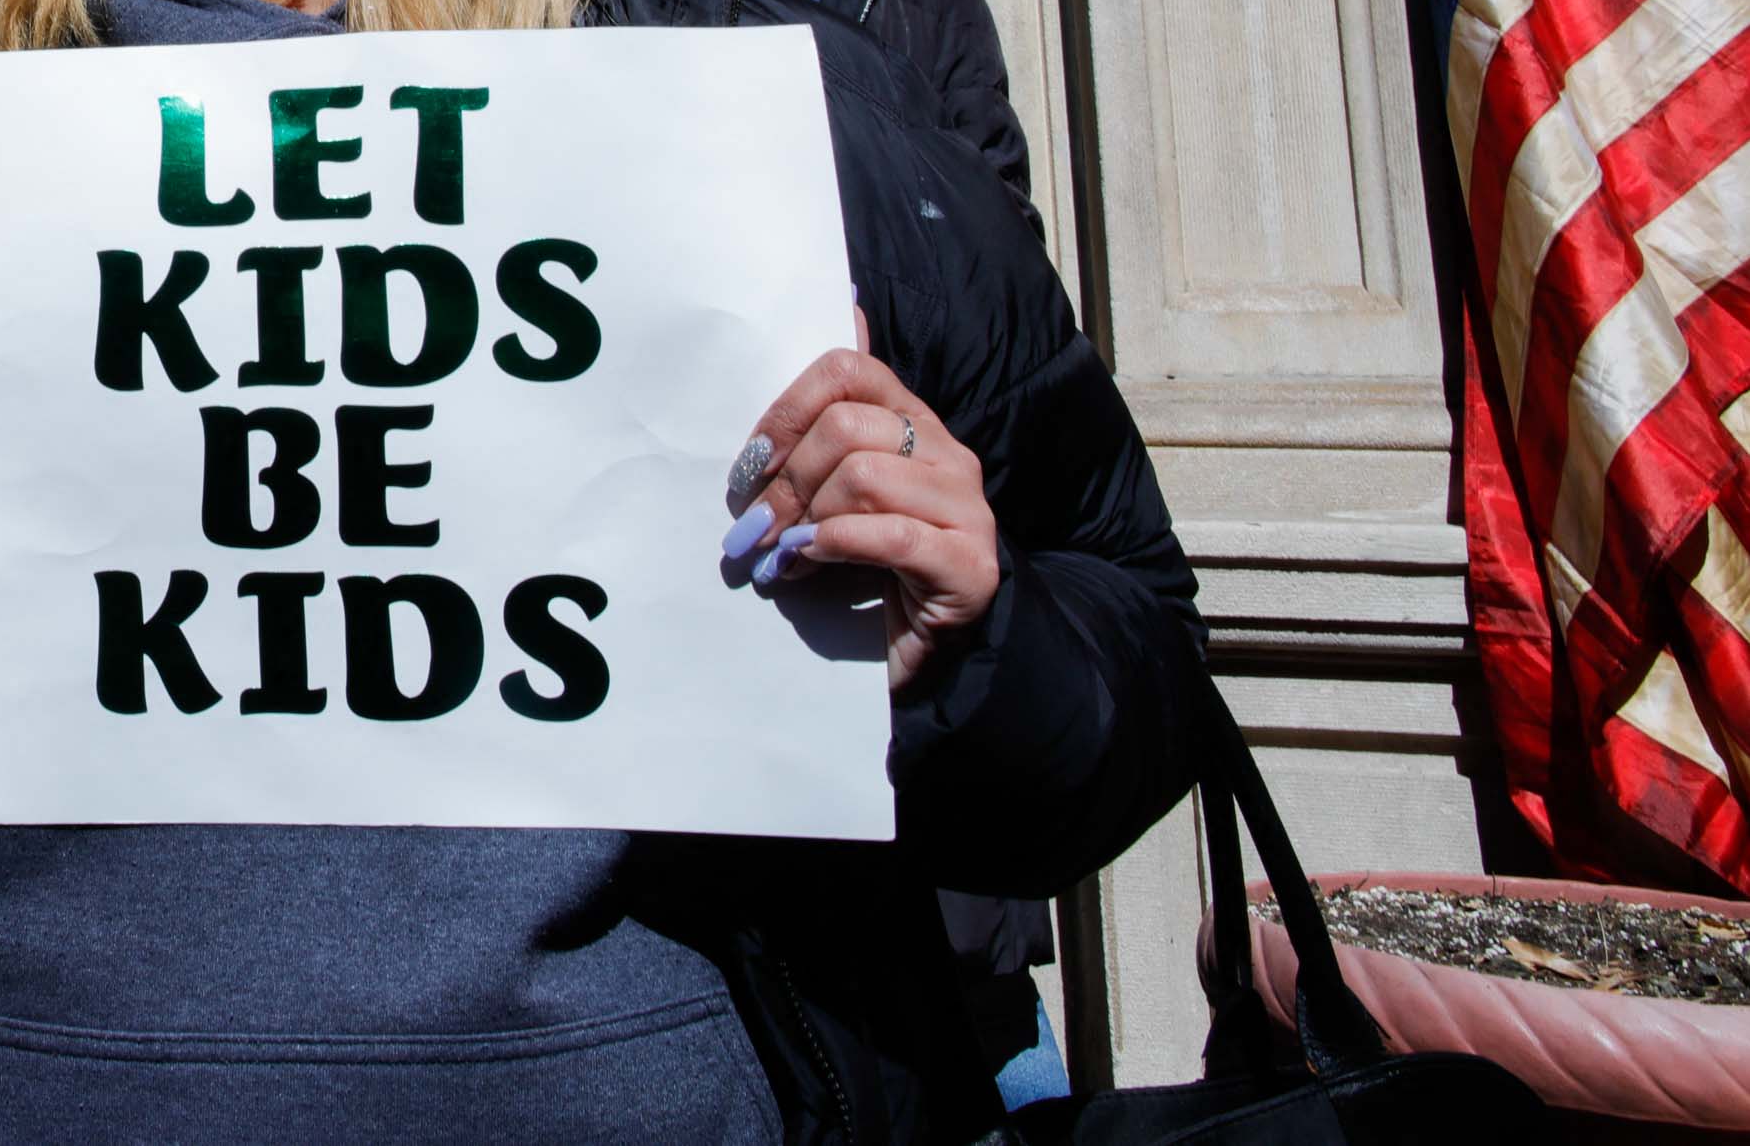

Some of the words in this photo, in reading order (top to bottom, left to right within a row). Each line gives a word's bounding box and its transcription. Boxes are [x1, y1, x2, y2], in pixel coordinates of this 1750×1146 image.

[156, 84, 490, 228] LET
[93, 237, 603, 394] KIDS
[198, 403, 441, 550] BE
[93, 569, 611, 723] KIDS
